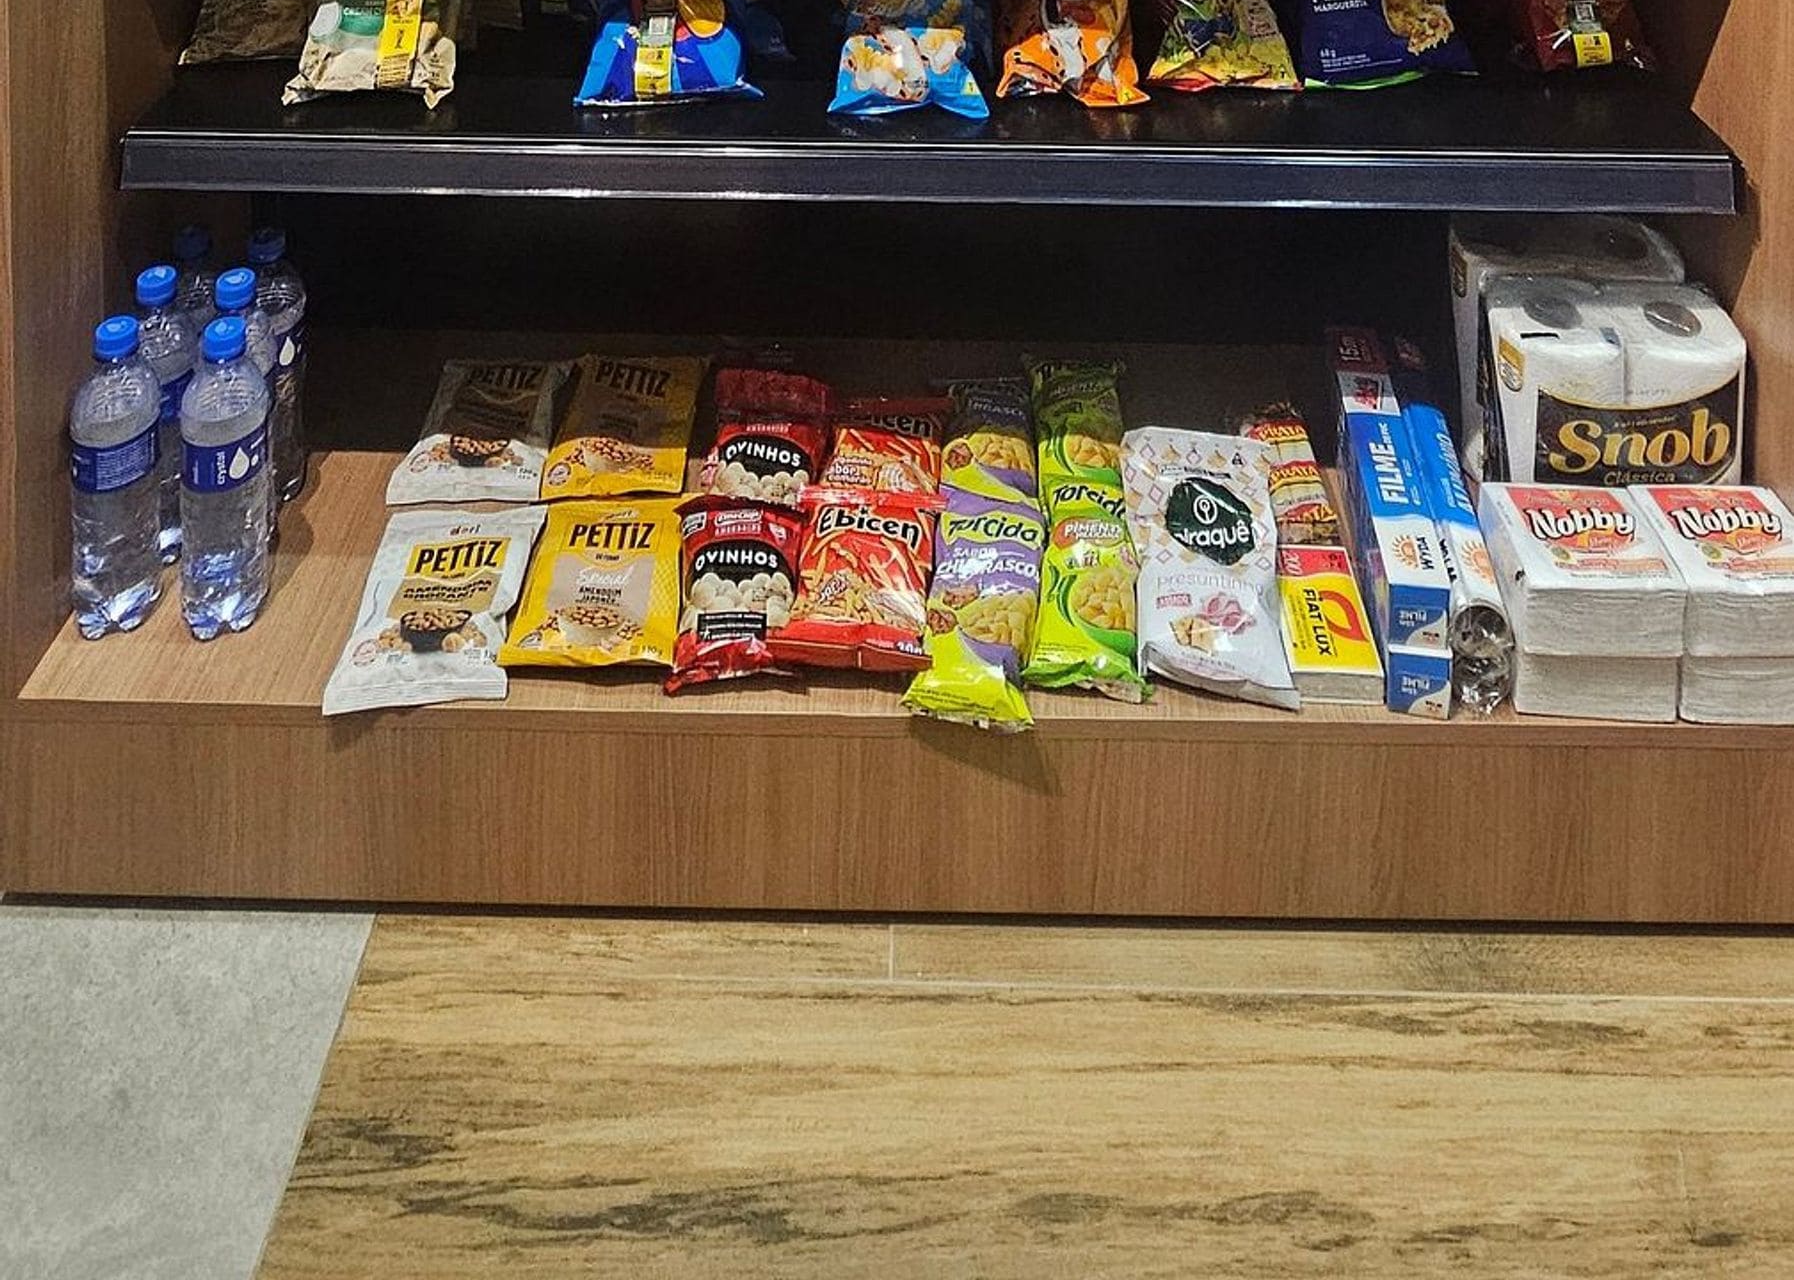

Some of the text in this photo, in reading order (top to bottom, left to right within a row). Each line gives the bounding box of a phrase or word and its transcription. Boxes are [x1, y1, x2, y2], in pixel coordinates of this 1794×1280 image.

[1258, 425, 1306, 440] PRATA
[1548, 408, 1731, 478] Snob
[725, 440, 801, 467] OVINHOS
[1269, 464, 1319, 481] PRATA
[1368, 442, 1410, 505] FILME
[568, 522, 656, 549] PETTIZ
[818, 506, 921, 548] Ebicen
[949, 517, 1039, 543] Torcida
[1528, 507, 1637, 542] Nobby
[1672, 506, 1784, 542] Nobby
[414, 540, 502, 574] PETTIZ
[695, 550, 778, 571] OVINHOS
[1303, 588, 1333, 656] FIAT LUX
